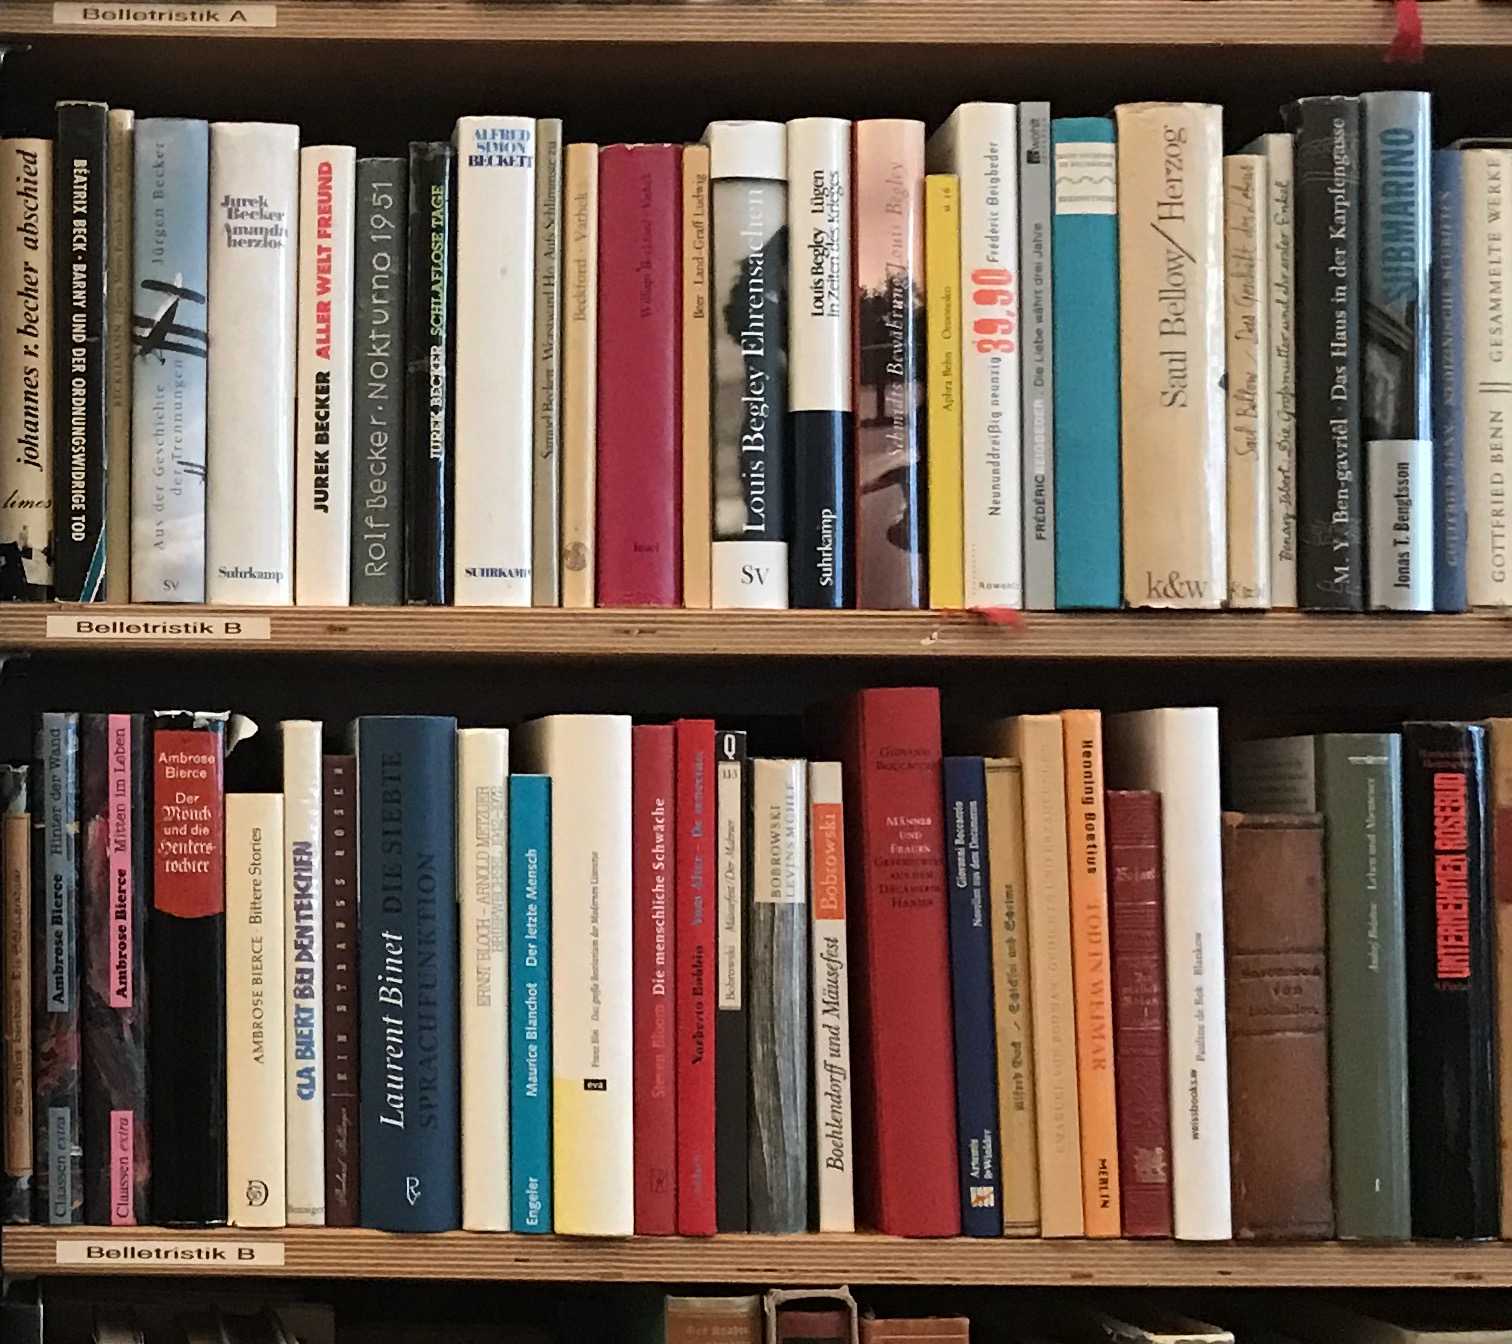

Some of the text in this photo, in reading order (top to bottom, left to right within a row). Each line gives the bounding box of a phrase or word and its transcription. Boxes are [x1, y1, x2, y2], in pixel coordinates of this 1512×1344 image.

[82, 8, 247, 22] Belletristik A
[314, 161, 333, 513] JUREK BECKER ALLER WELT FREUND
[809, 170, 828, 317] Louis Begley Lügen
[1486, 159, 1506, 583] GOTTFRIED BENN GESAMMELTE WERKE
[76, 621, 242, 635] Belletristik B
[818, 508, 834, 586] Suhrkamp
[112, 728, 127, 999] Ambrose Bierce Mitten im Leben
[524, 849, 538, 1096] Maurice Blanchot Der letzte Mensch
[820, 813, 845, 1171] Boehlendorff und Mäusefest Bobrowski
[86, 1246, 255, 1260] Belletristik B
